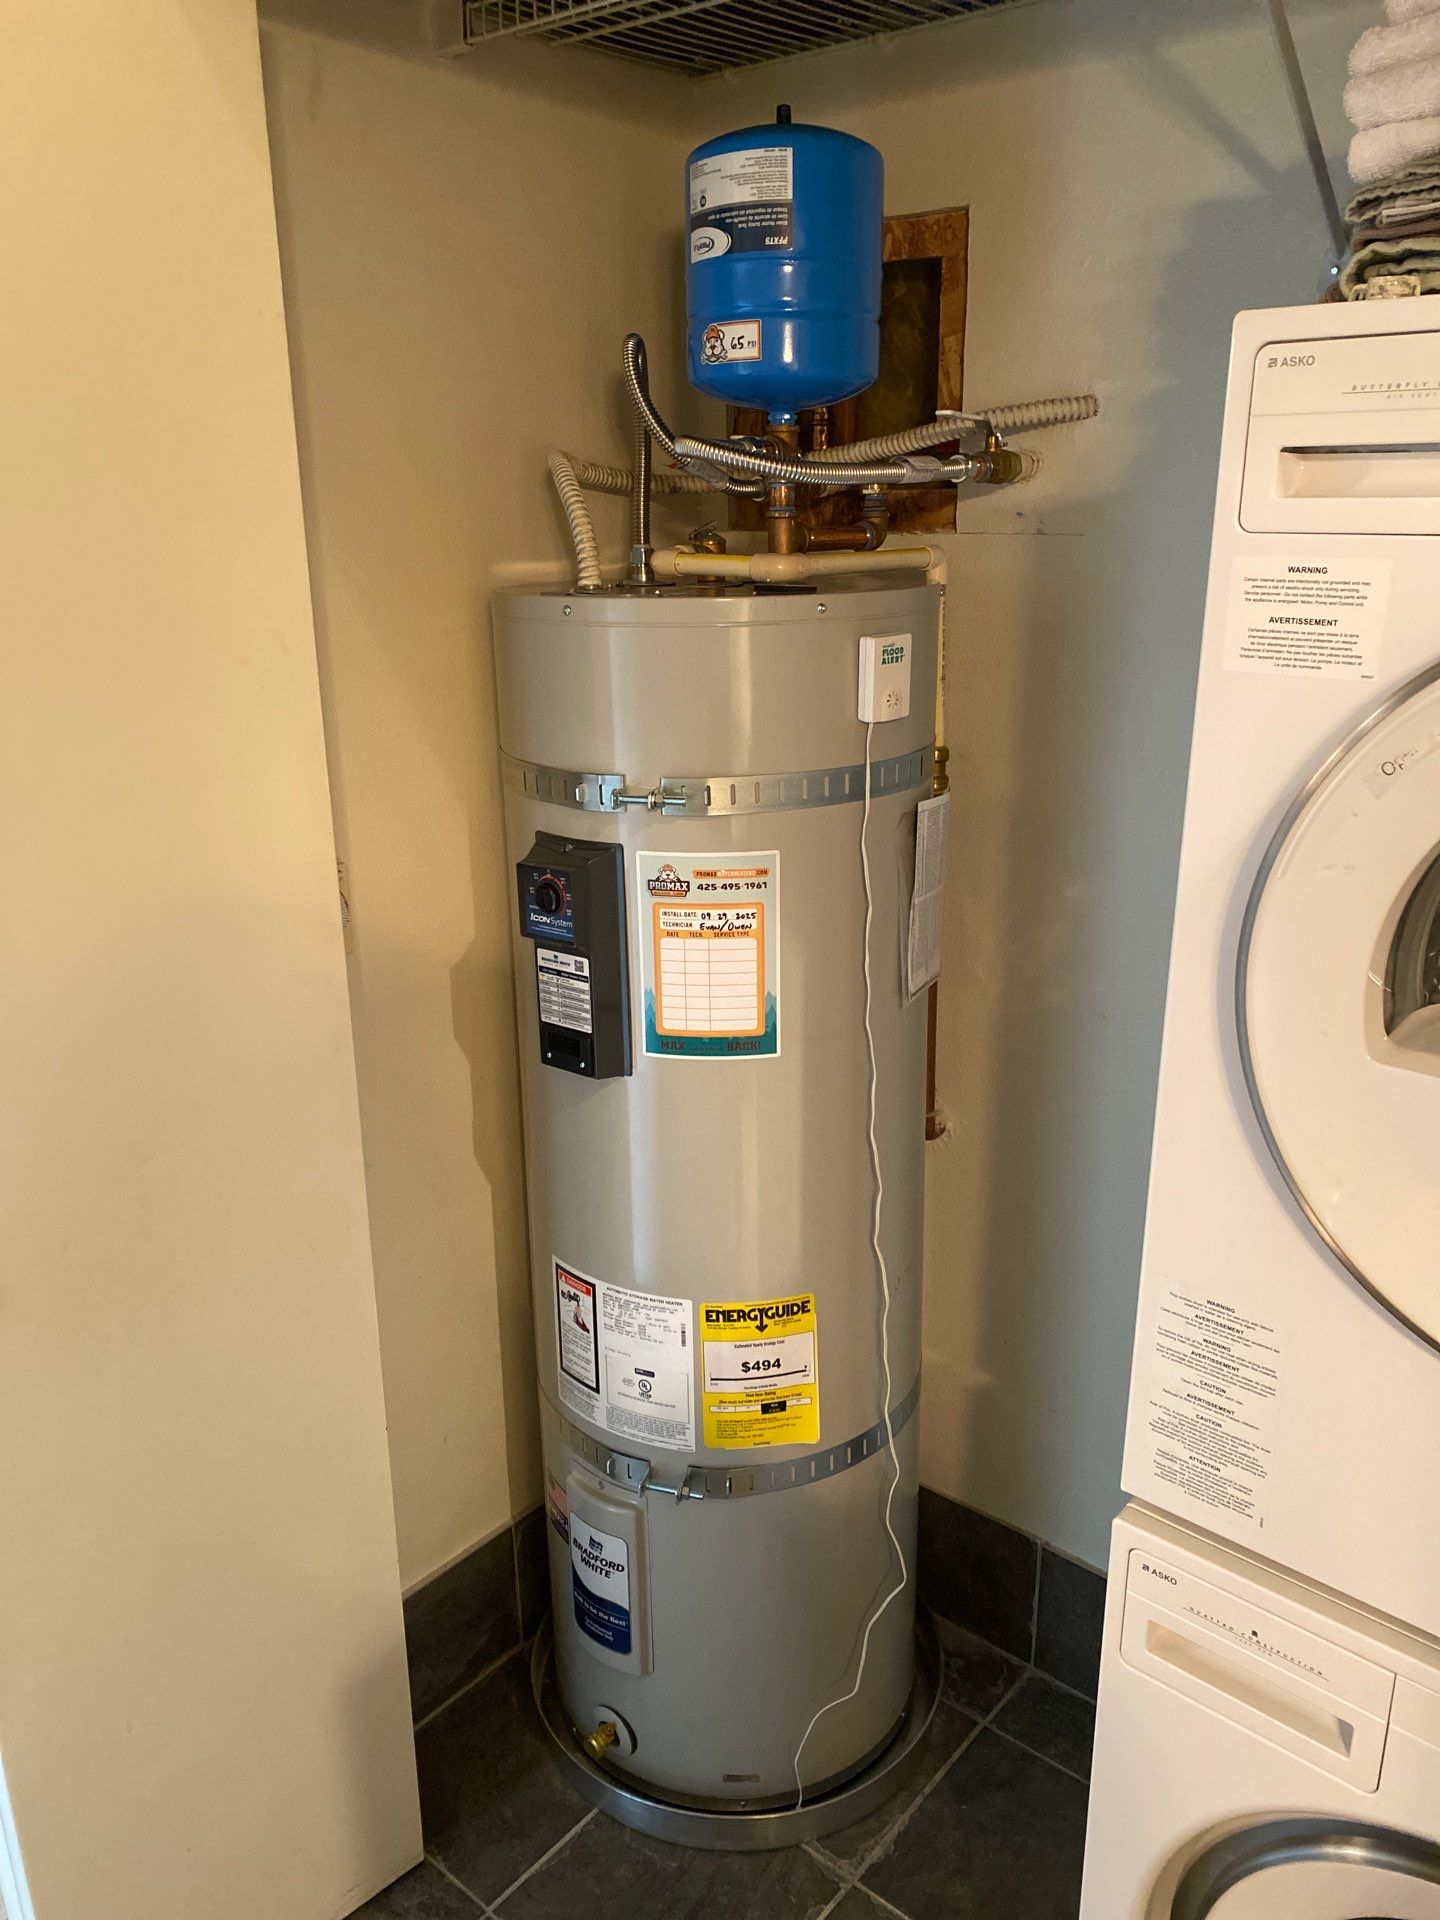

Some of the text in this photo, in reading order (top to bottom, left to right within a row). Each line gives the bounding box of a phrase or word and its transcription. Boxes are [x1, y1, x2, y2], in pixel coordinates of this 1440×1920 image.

[765, 236, 788, 245] PFXT5
[730, 335, 744, 349] 65
[1280, 355, 1315, 367] ASKO
[1352, 381, 1426, 391] BUTTERFLY
[1288, 566, 1328, 574] WARNING
[1269, 617, 1338, 627] AVERTISSEMENT
[882, 646, 904, 657] FLOOD
[881, 655, 904, 665] ALERT
[649, 881, 688, 891] PROMAX
[701, 912, 711, 920] 09
[735, 912, 756, 920] 2025
[660, 1041, 685, 1050] MAX
[727, 1041, 761, 1051] BACK!
[567, 1278, 587, 1293] DANGER
[705, 1300, 810, 1323] ENERGYGUIDE
[1206, 1299, 1235, 1314] WARNING
[1194, 1314, 1244, 1335] AVERTISSEMENT
[1202, 1337, 1231, 1353] WARNING
[741, 1358, 781, 1373] $494
[1190, 1350, 1240, 1373] AVERTISSEMENT
[1199, 1380, 1226, 1394] CAUTION
[1186, 1393, 1235, 1416] AVERTISSEMENT
[1195, 1414, 1223, 1428] CAUTION
[1188, 1455, 1221, 1473] ATTENTION
[572, 1537, 625, 1573] BRADFORD
[580, 1553, 611, 1579] WHITE
[1151, 1569, 1177, 1585] ASKO
[609, 1616, 626, 1626] Best
[1189, 1607, 1234, 1631] QUATTRO
[1241, 1632, 1323, 1676] CONSTRUCTION
